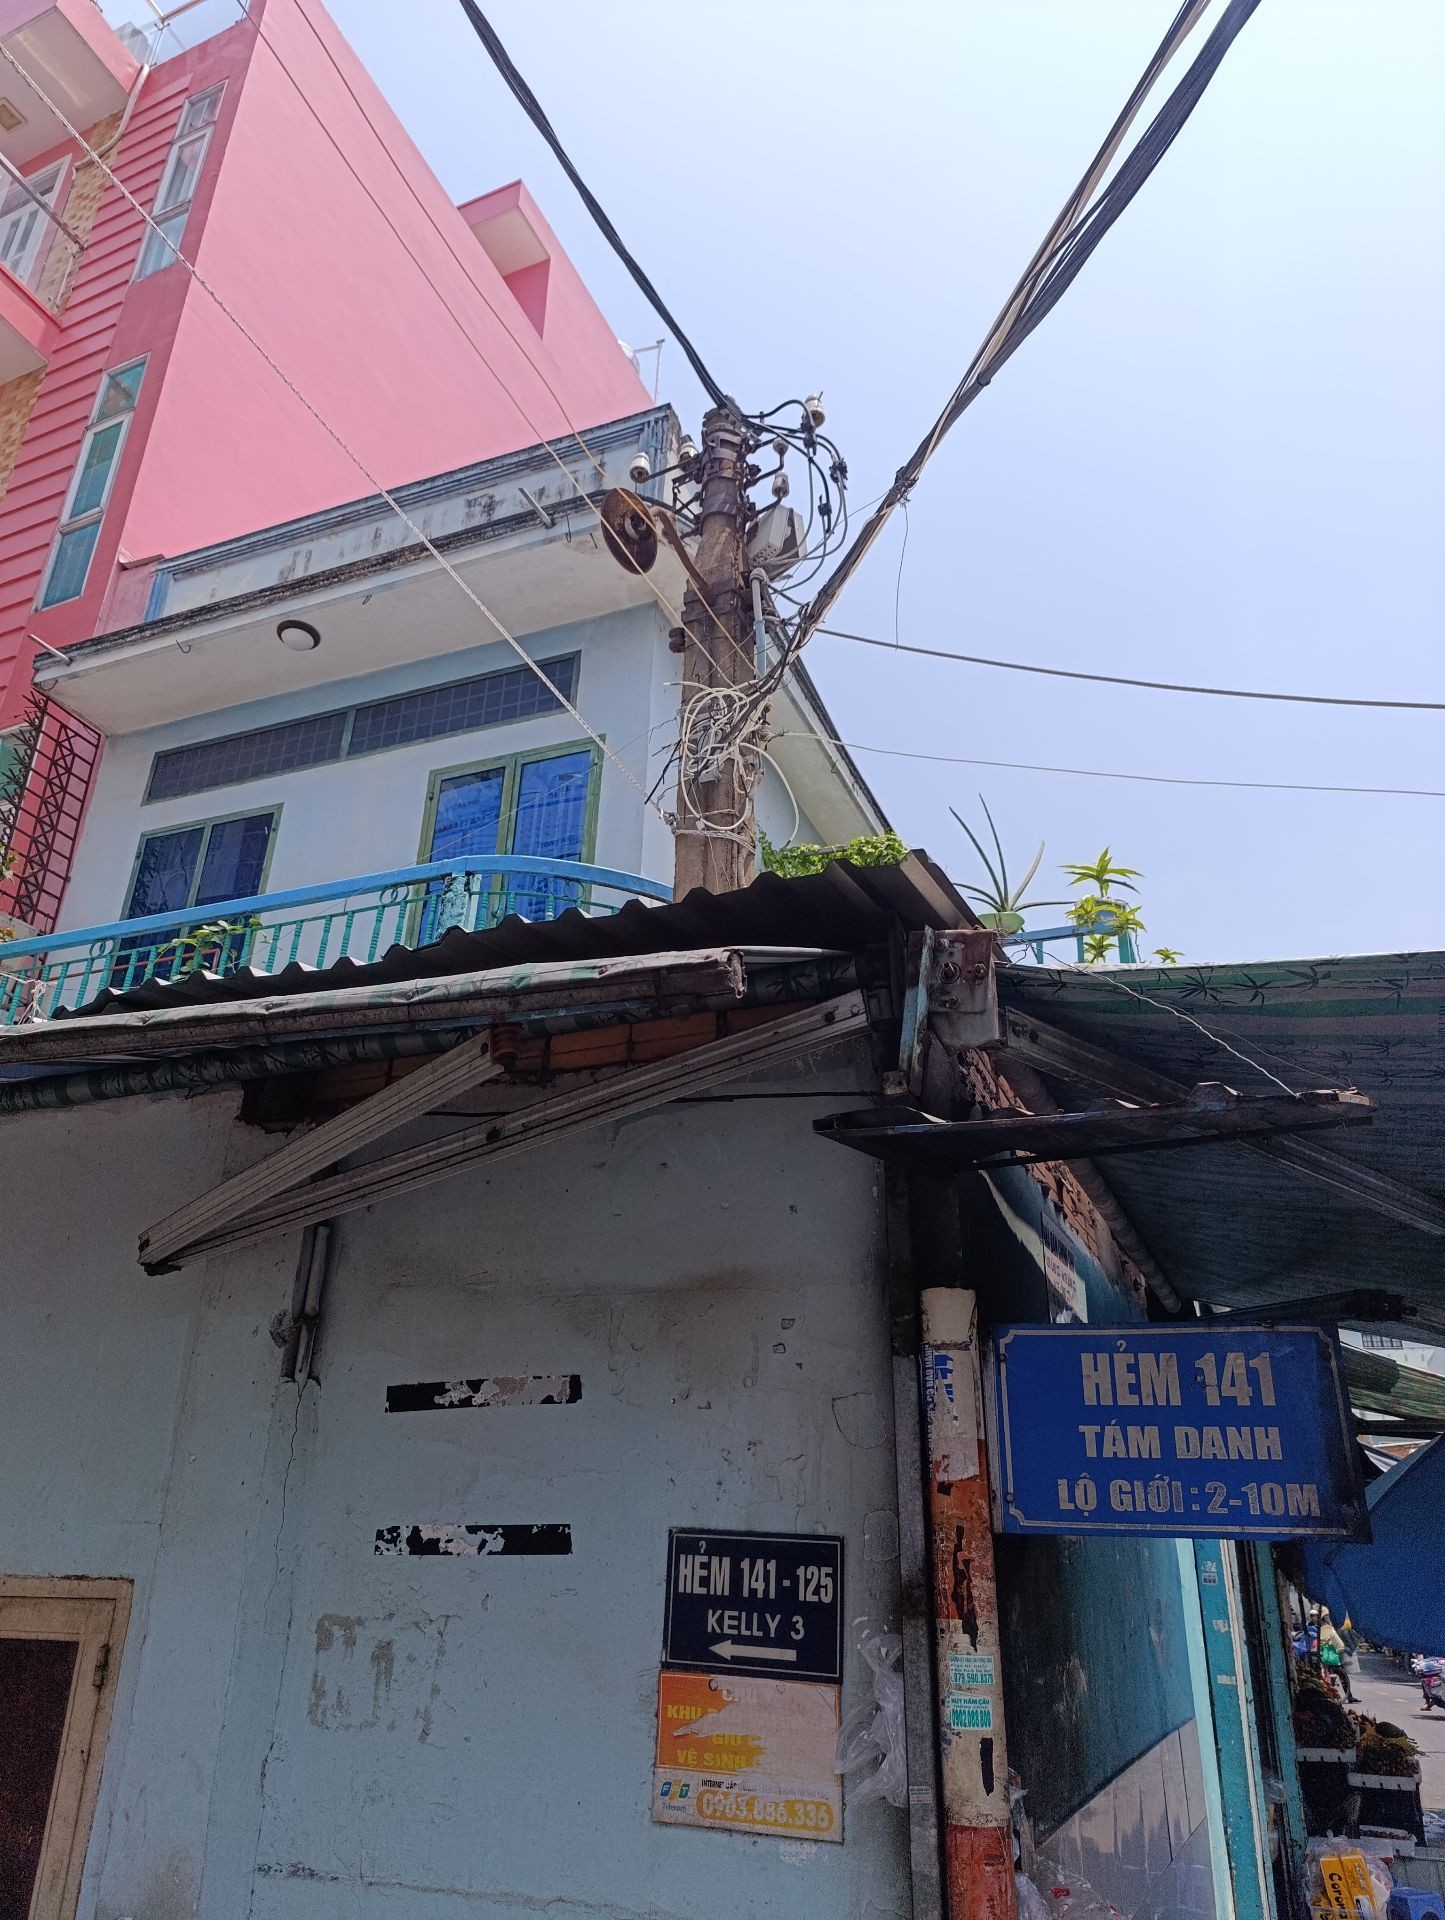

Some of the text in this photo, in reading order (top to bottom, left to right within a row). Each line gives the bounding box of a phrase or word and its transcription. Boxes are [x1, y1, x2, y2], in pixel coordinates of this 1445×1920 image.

[1080, 1339, 1277, 1406] HẺM 141
[1079, 1418, 1283, 1460] TÁM DANH
[1057, 1472, 1098, 1517] LỘ
[1205, 1482, 1321, 1517] 2-10M
[678, 1540, 731, 1596] HẺM
[740, 1557, 776, 1600] 141
[796, 1565, 834, 1604] 125
[707, 1608, 805, 1641] KELLY 3
[703, 1752, 749, 1770] SINH
